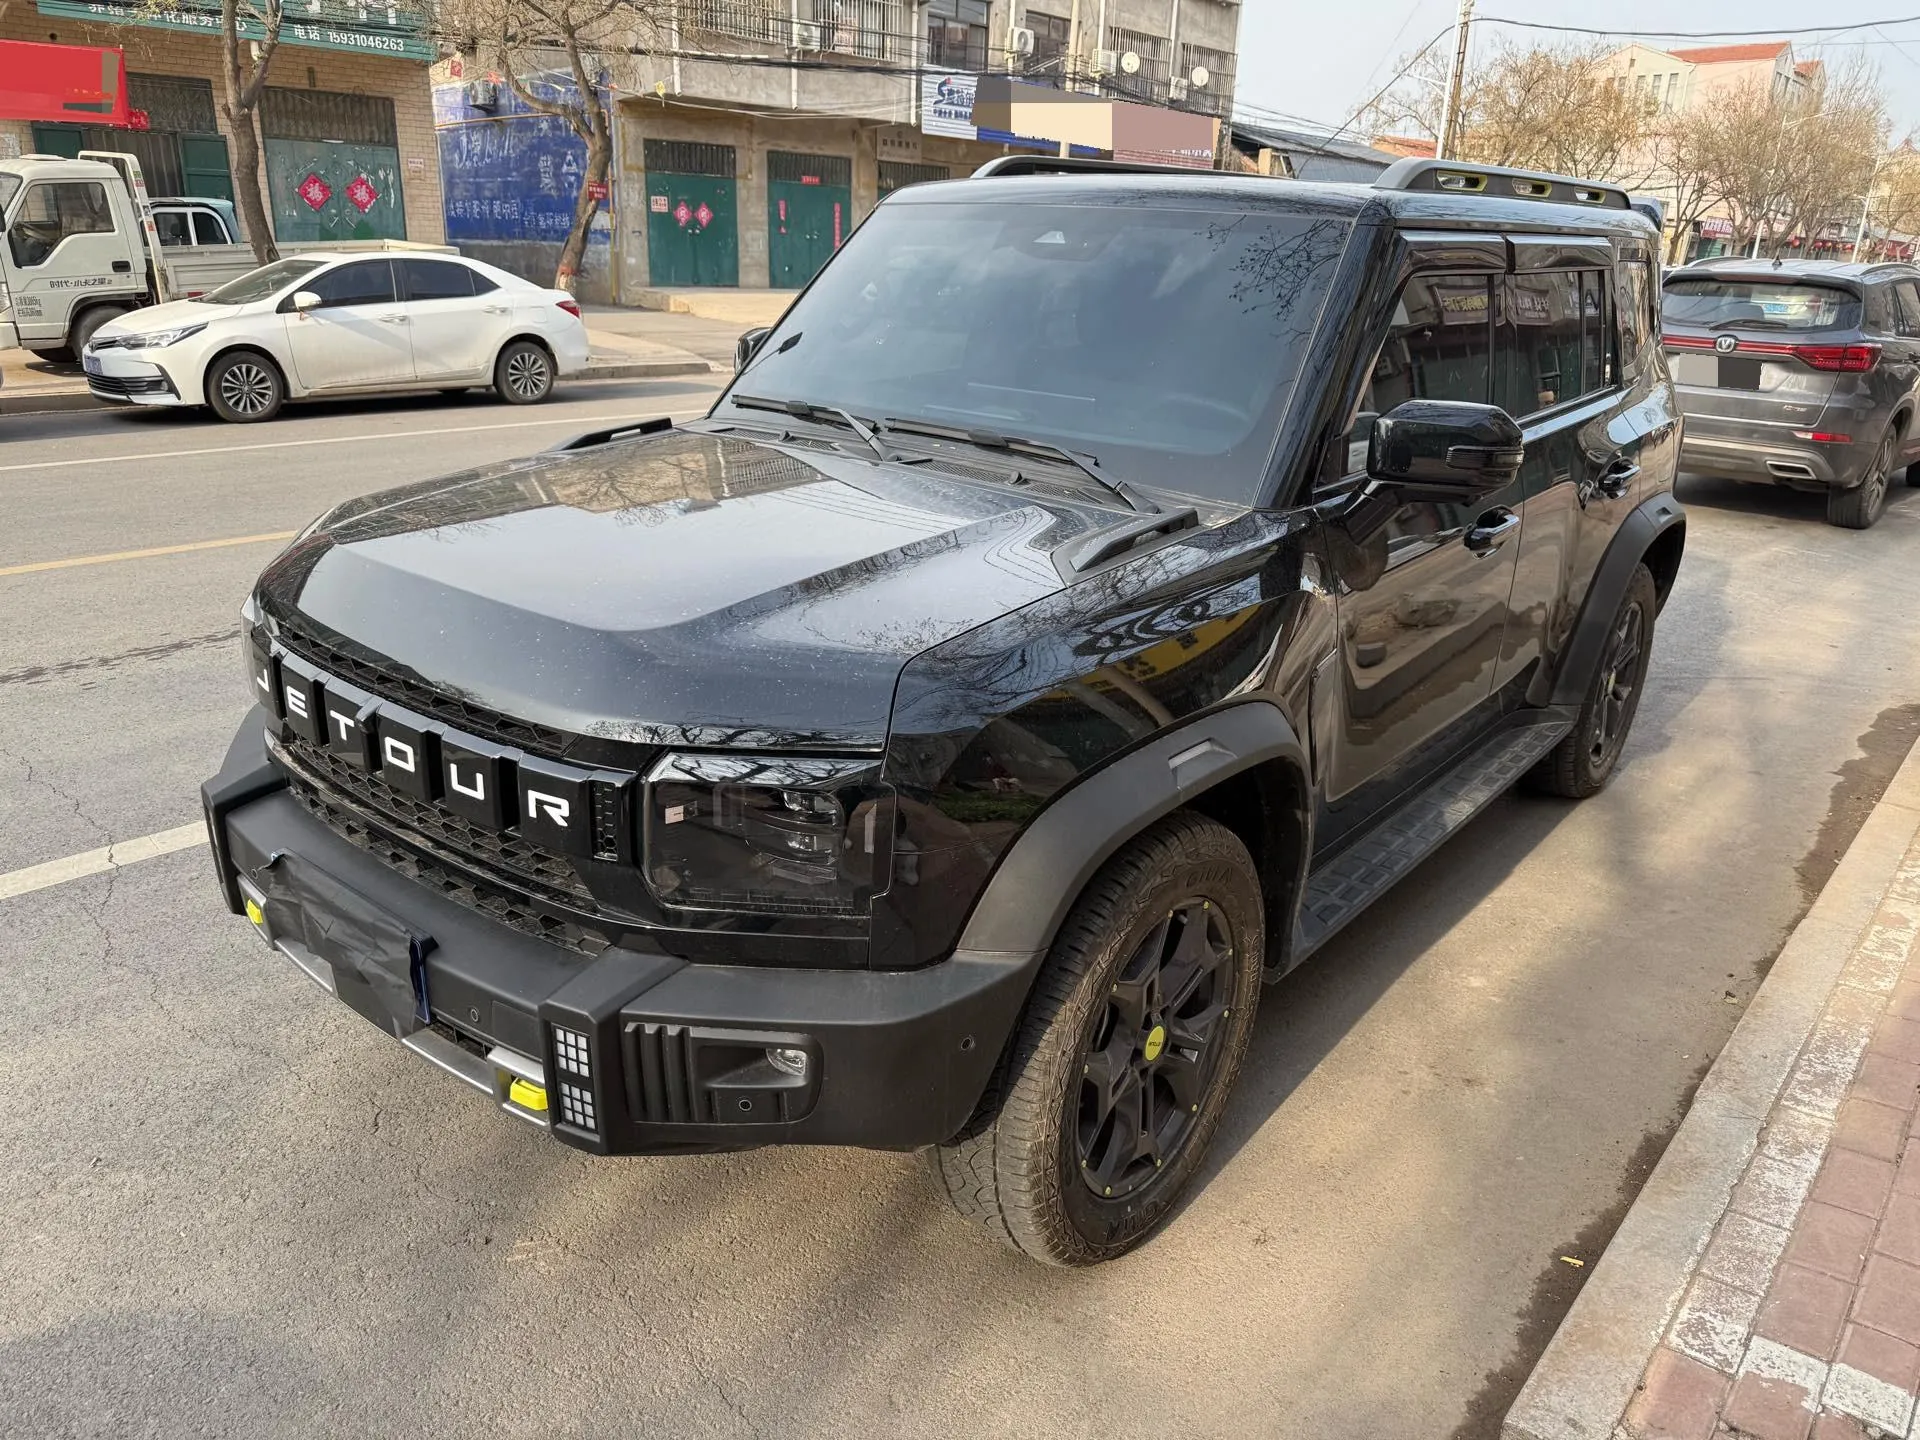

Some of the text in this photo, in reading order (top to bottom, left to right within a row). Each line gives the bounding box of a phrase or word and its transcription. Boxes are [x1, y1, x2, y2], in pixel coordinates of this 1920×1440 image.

[293, 24, 405, 51] 电话 15931046263
[256, 668, 570, 827] JETOUR
